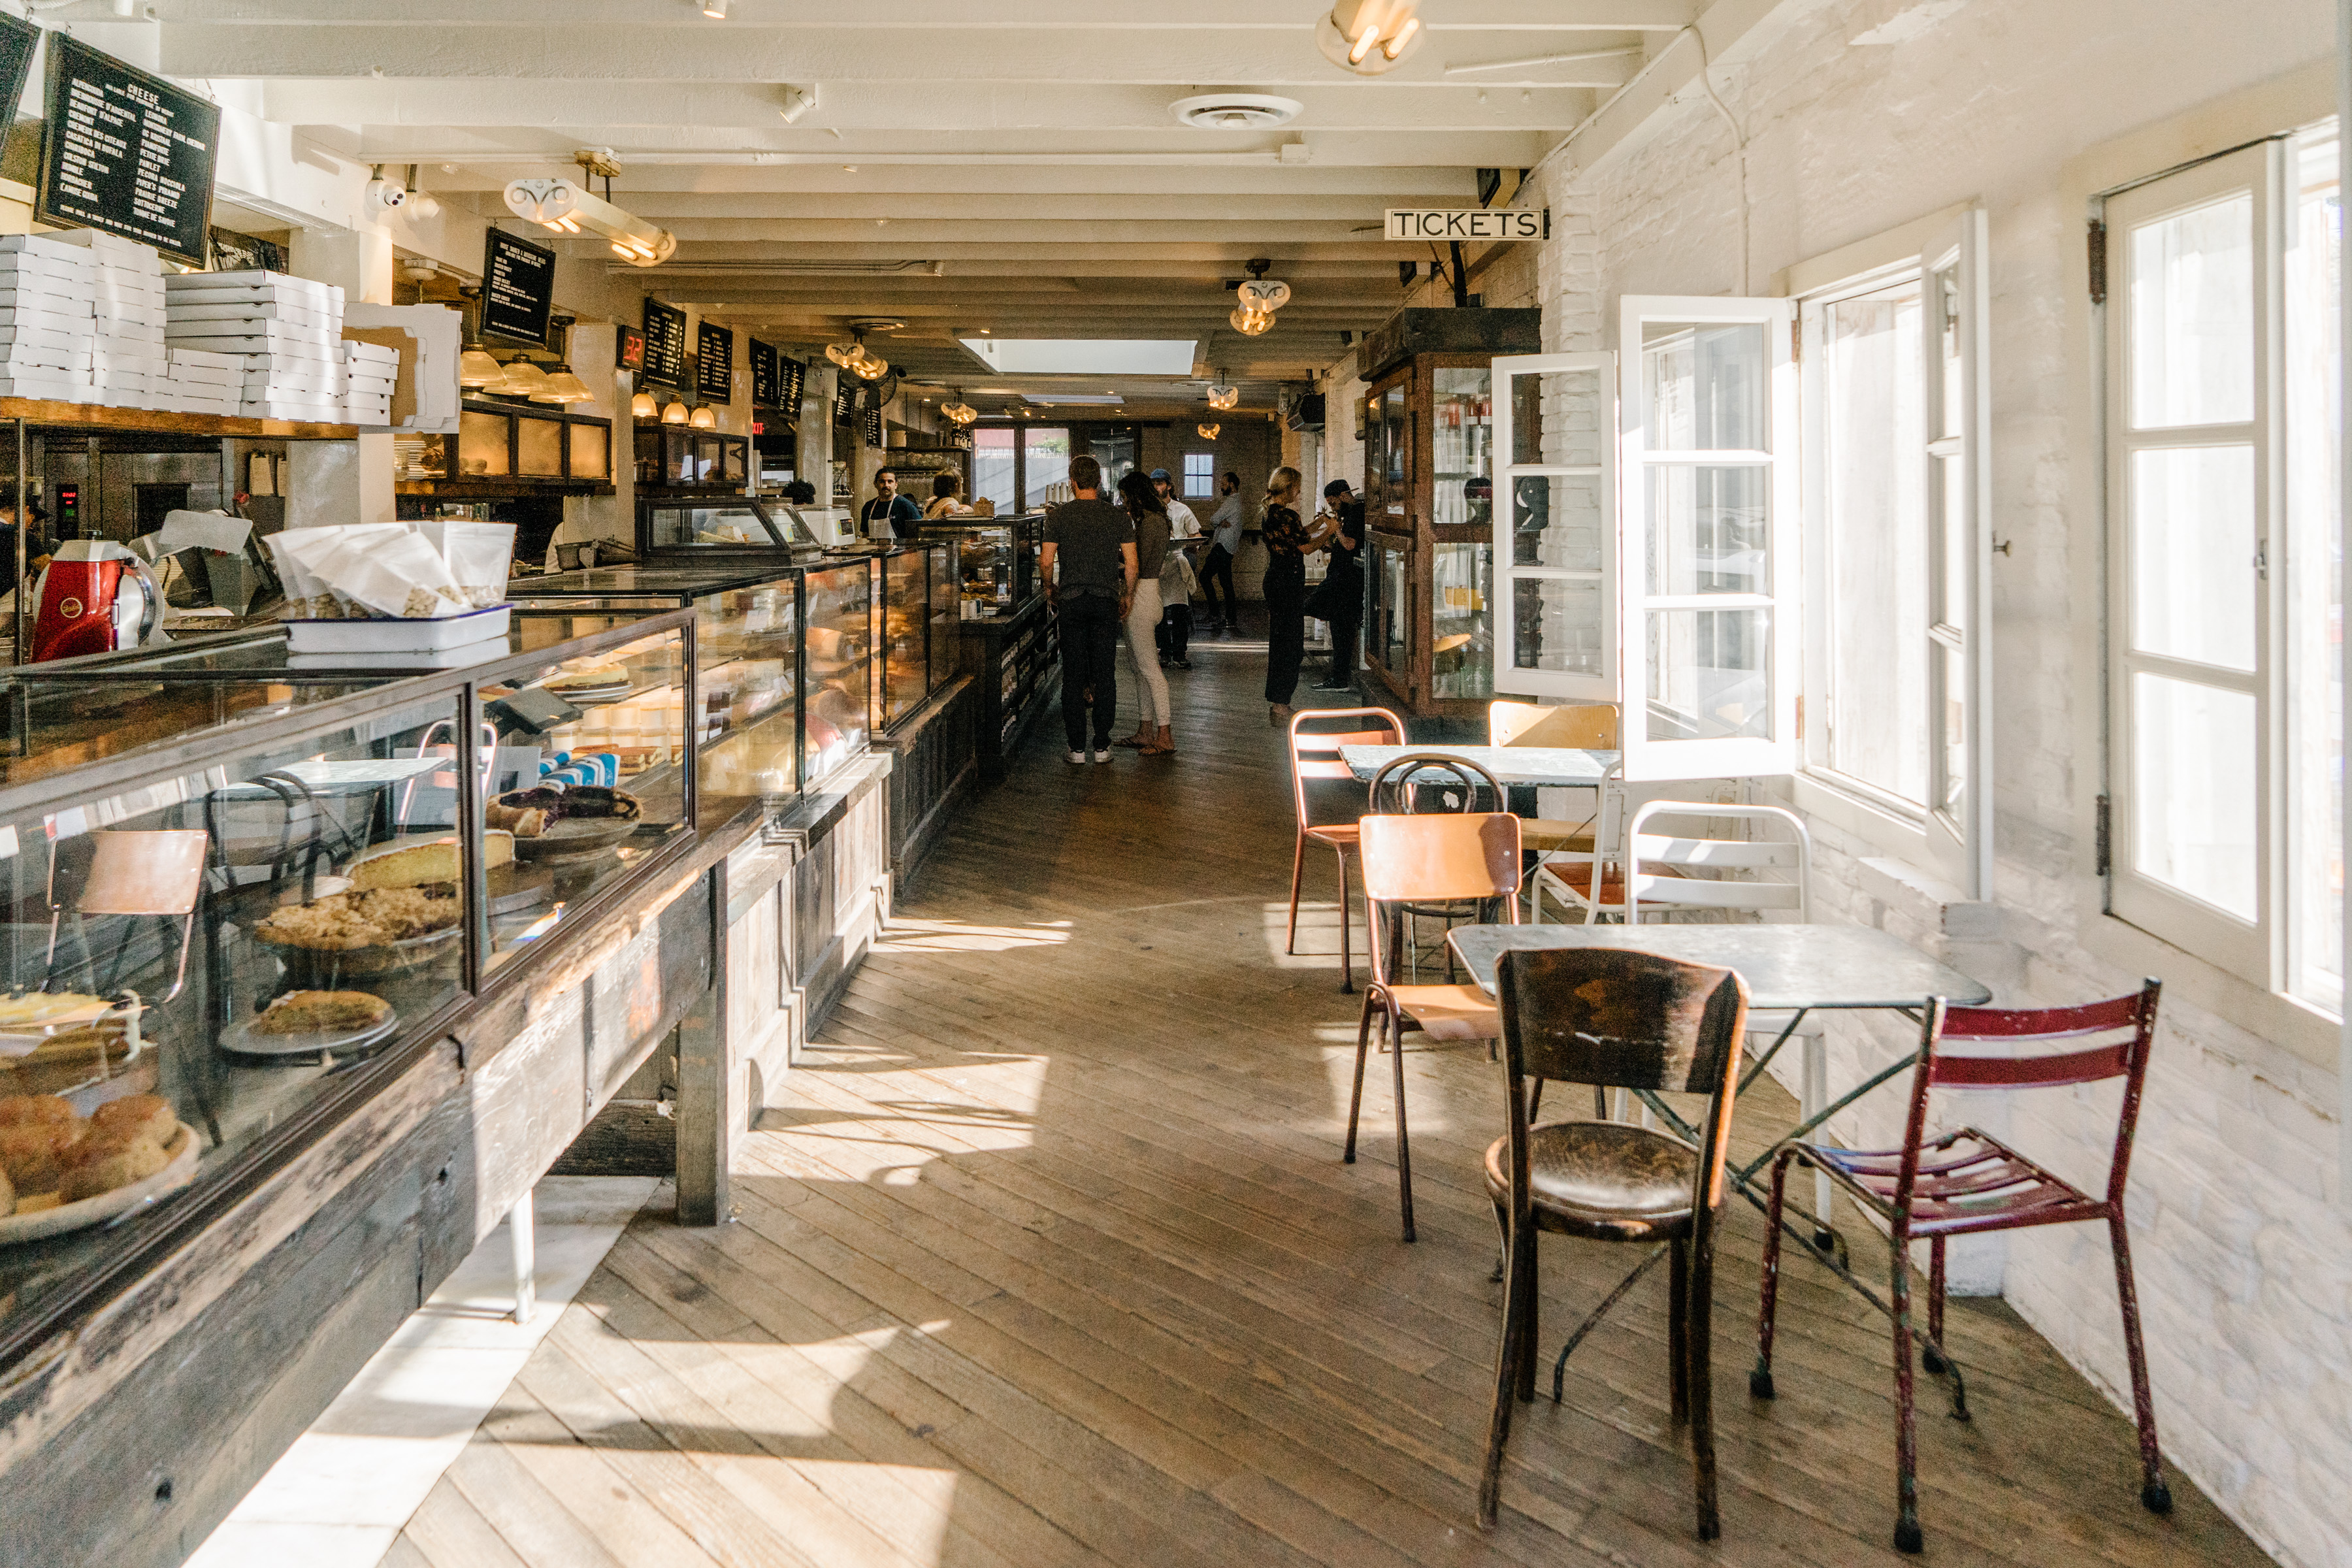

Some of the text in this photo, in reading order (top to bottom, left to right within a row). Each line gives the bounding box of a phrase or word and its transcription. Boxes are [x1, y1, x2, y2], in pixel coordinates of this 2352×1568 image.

[127, 84, 159, 105] CHEESE
[66, 131, 93, 147] CASATICA
[140, 148, 157, 161] PETITE
[139, 159, 161, 172] PAWLET
[138, 168, 158, 182] PECORA
[157, 195, 178, 208] BREEZE
[1394, 212, 1537, 237] TICKETS
[623, 336, 643, 361] 32
[752, 422, 764, 434] XIT
